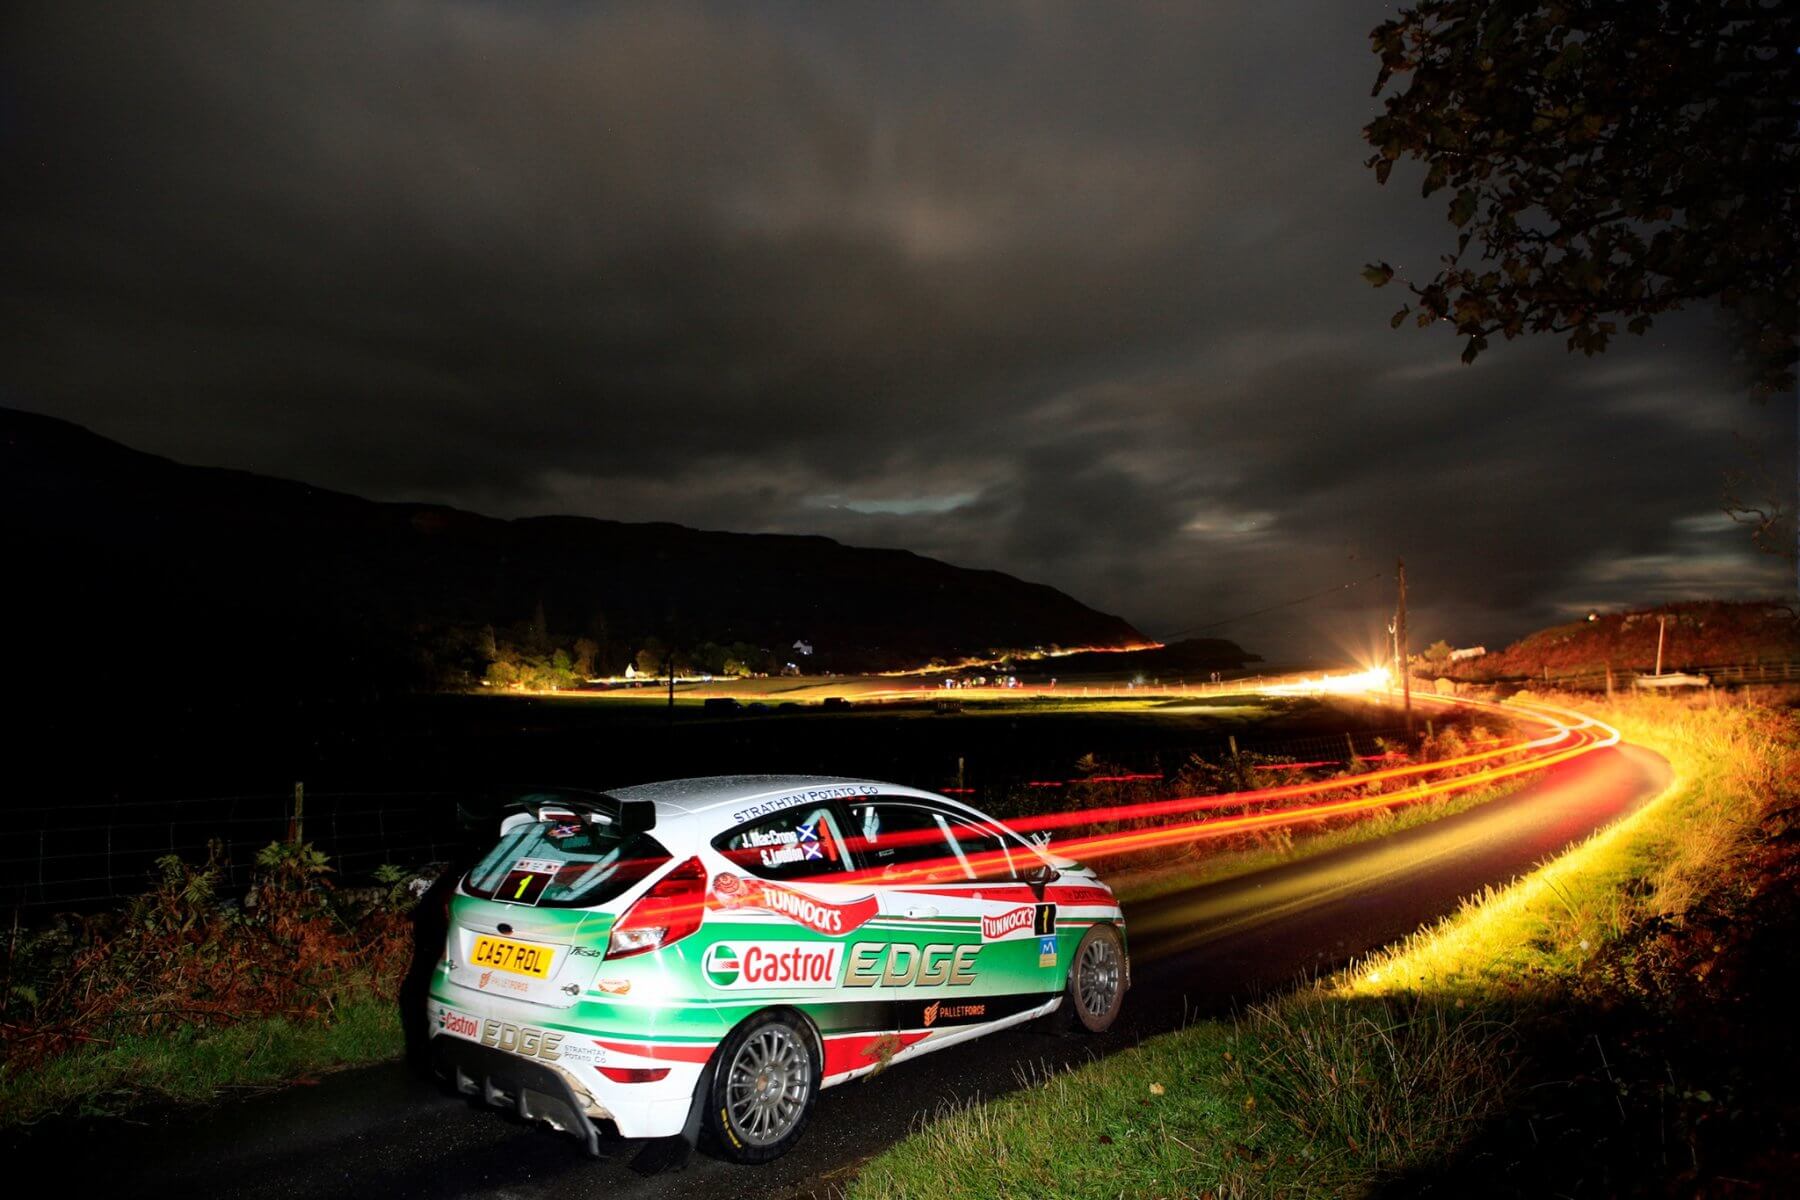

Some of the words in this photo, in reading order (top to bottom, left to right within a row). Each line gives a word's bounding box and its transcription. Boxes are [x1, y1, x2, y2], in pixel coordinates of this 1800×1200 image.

[733, 794, 806, 823] STRATHTAY
[808, 787, 856, 801] POTATO
[514, 874, 534, 899] 1
[761, 886, 842, 931] TUNNOCK'S
[983, 907, 1034, 936] TUNNOCK'S
[1043, 905, 1049, 934] 1
[476, 940, 514, 965] CA57
[514, 947, 542, 974] ROL
[743, 946, 834, 983] Castrol
[842, 942, 985, 988] EDGE
[940, 1004, 986, 1018] PALLETFORCE
[445, 1011, 479, 1038] Castrol
[480, 1018, 566, 1062] EDGE
[564, 1044, 607, 1057] STRATHTAY
[564, 1052, 592, 1063] POTATO
